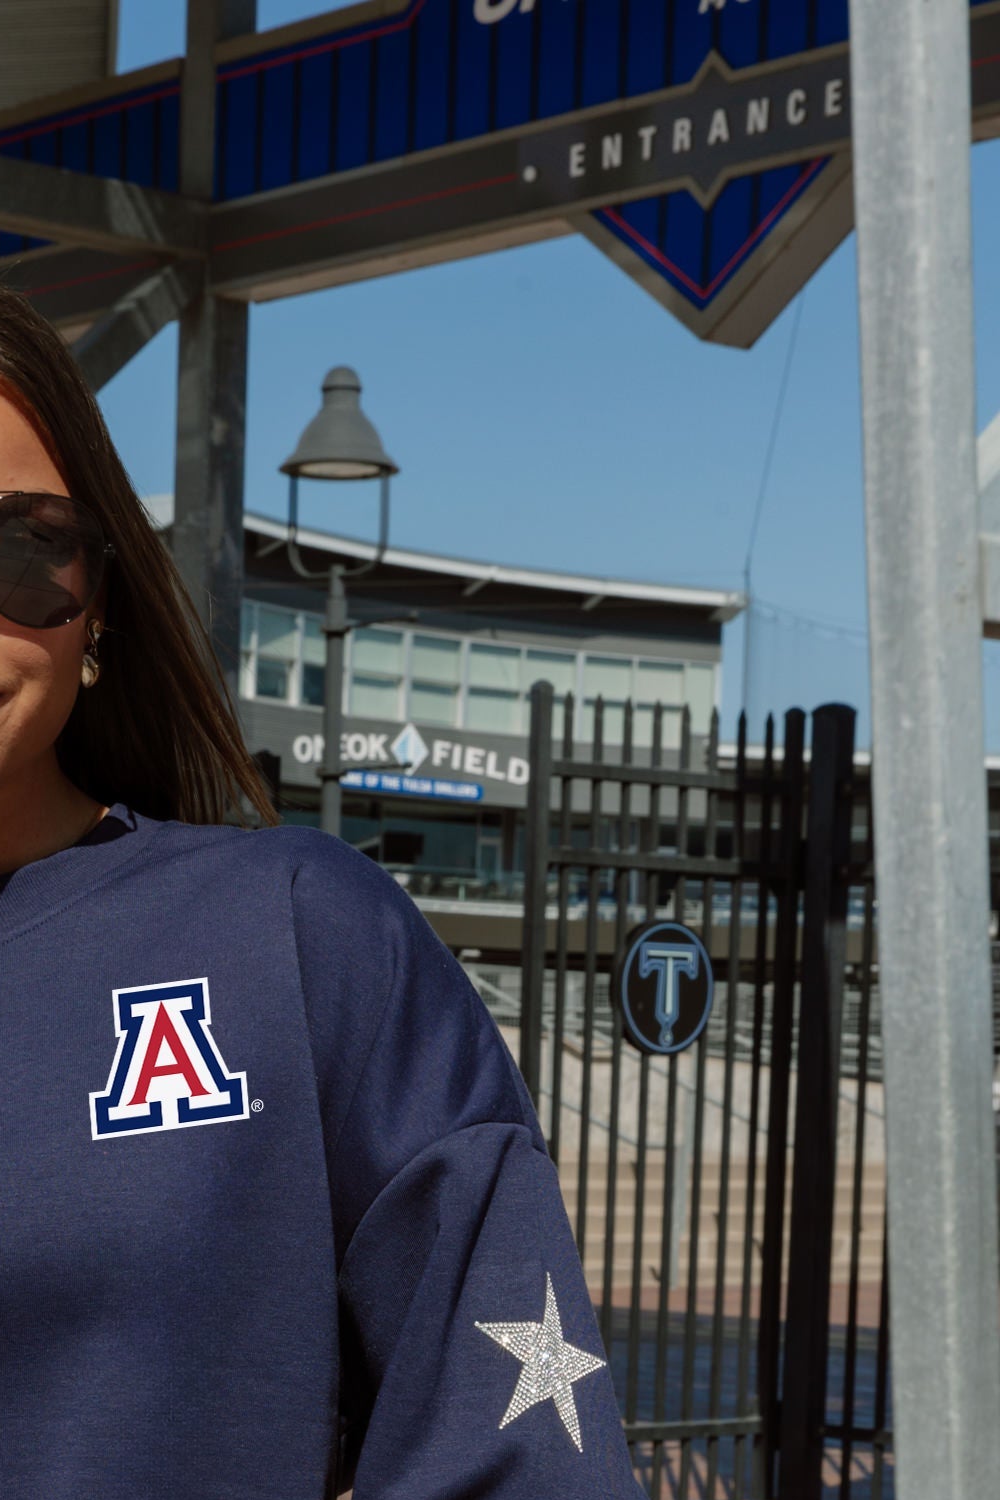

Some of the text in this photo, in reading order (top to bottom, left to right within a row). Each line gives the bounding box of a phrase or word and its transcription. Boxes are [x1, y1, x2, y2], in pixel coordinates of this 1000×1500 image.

[568, 79, 844, 178] ENTRANCE
[432, 739, 530, 785] FIELD
[639, 941, 699, 1048] T
[89, 977, 250, 1140] A
